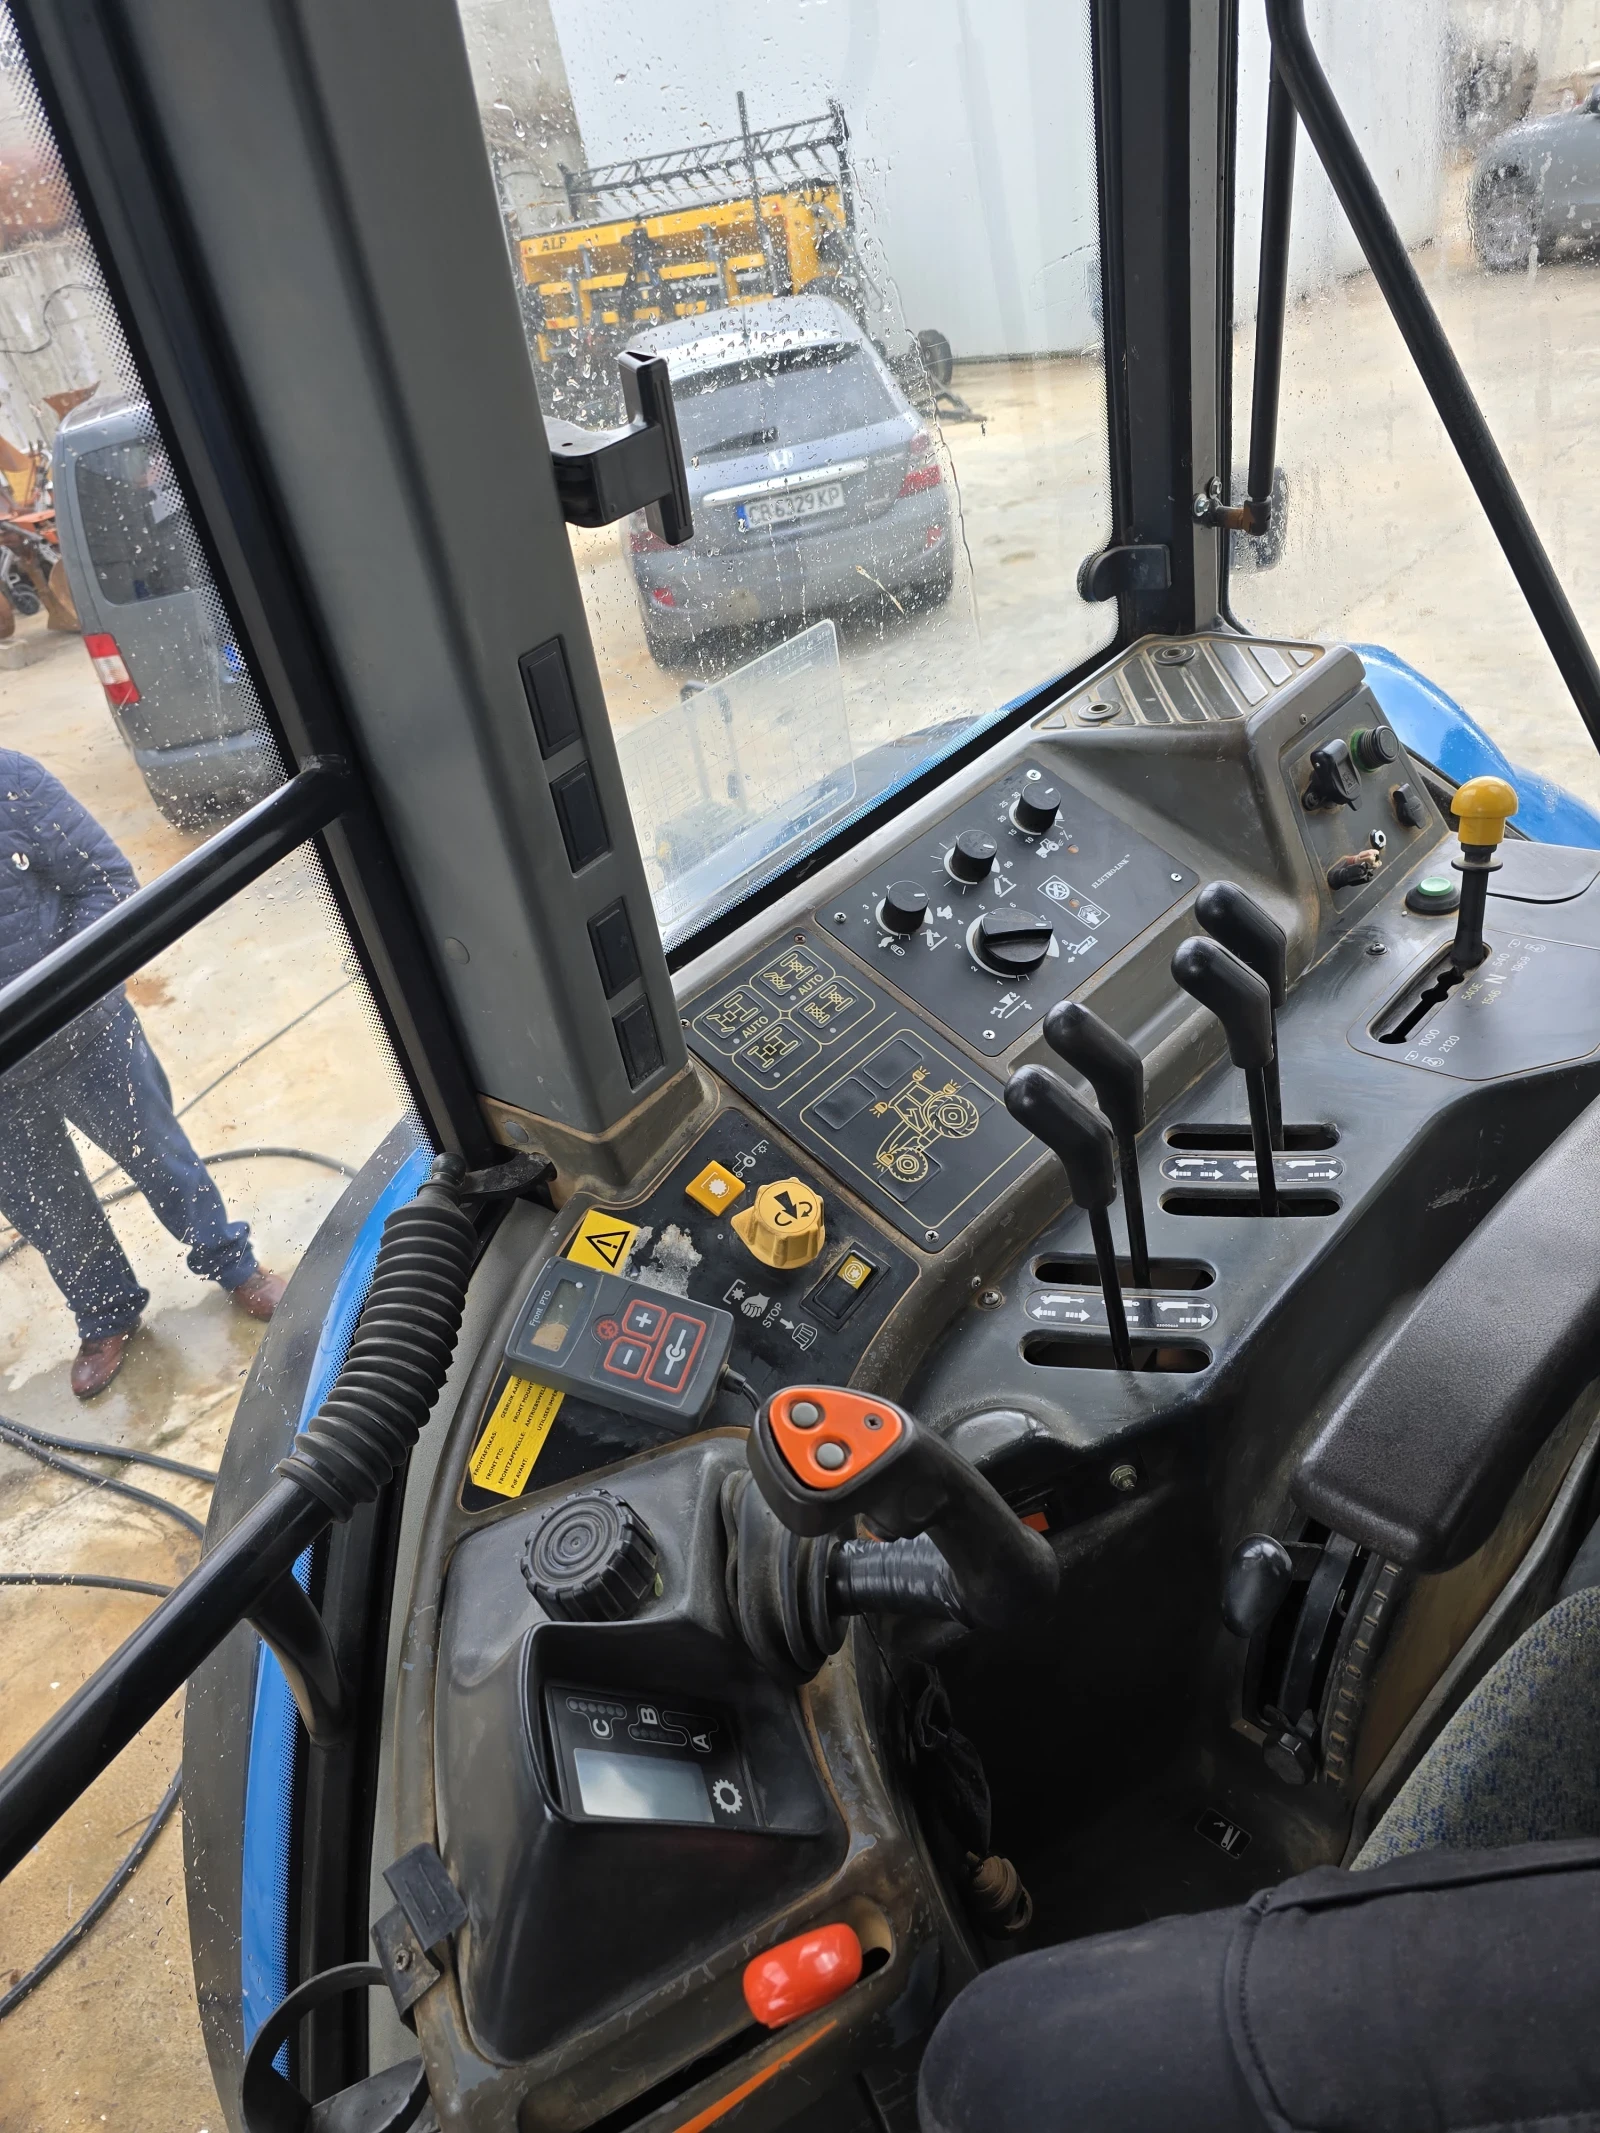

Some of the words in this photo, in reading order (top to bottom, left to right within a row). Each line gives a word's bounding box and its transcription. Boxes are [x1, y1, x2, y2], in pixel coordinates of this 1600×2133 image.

[541, 235, 567, 252] ALP
[1011, 791, 1021, 799] 30
[999, 800, 1008, 808] 25
[997, 815, 1007, 823] 20
[1025, 836, 1034, 844] 10
[1492, 952, 1510, 967] 540
[1510, 956, 1531, 972] 1969
[970, 965, 978, 973] 2
[798, 974, 824, 996] AUTO
[1484, 973, 1507, 985] N
[1461, 982, 1483, 1001] 540E
[1481, 989, 1501, 1006] 1546
[742, 1016, 769, 1039] AUTO
[1418, 1029, 1441, 1048] 1000
[1438, 1035, 1460, 1053] 2120
[528, 1307, 543, 1327] Front
[539, 1289, 552, 1306] PTO
[762, 1302, 782, 1329] STOP
[485, 1459, 498, 1480] FRONT
[512, 1403, 524, 1423] FRONT
[592, 1718, 610, 1737] C
[640, 1707, 658, 1725] B
[692, 1734, 710, 1750] A
